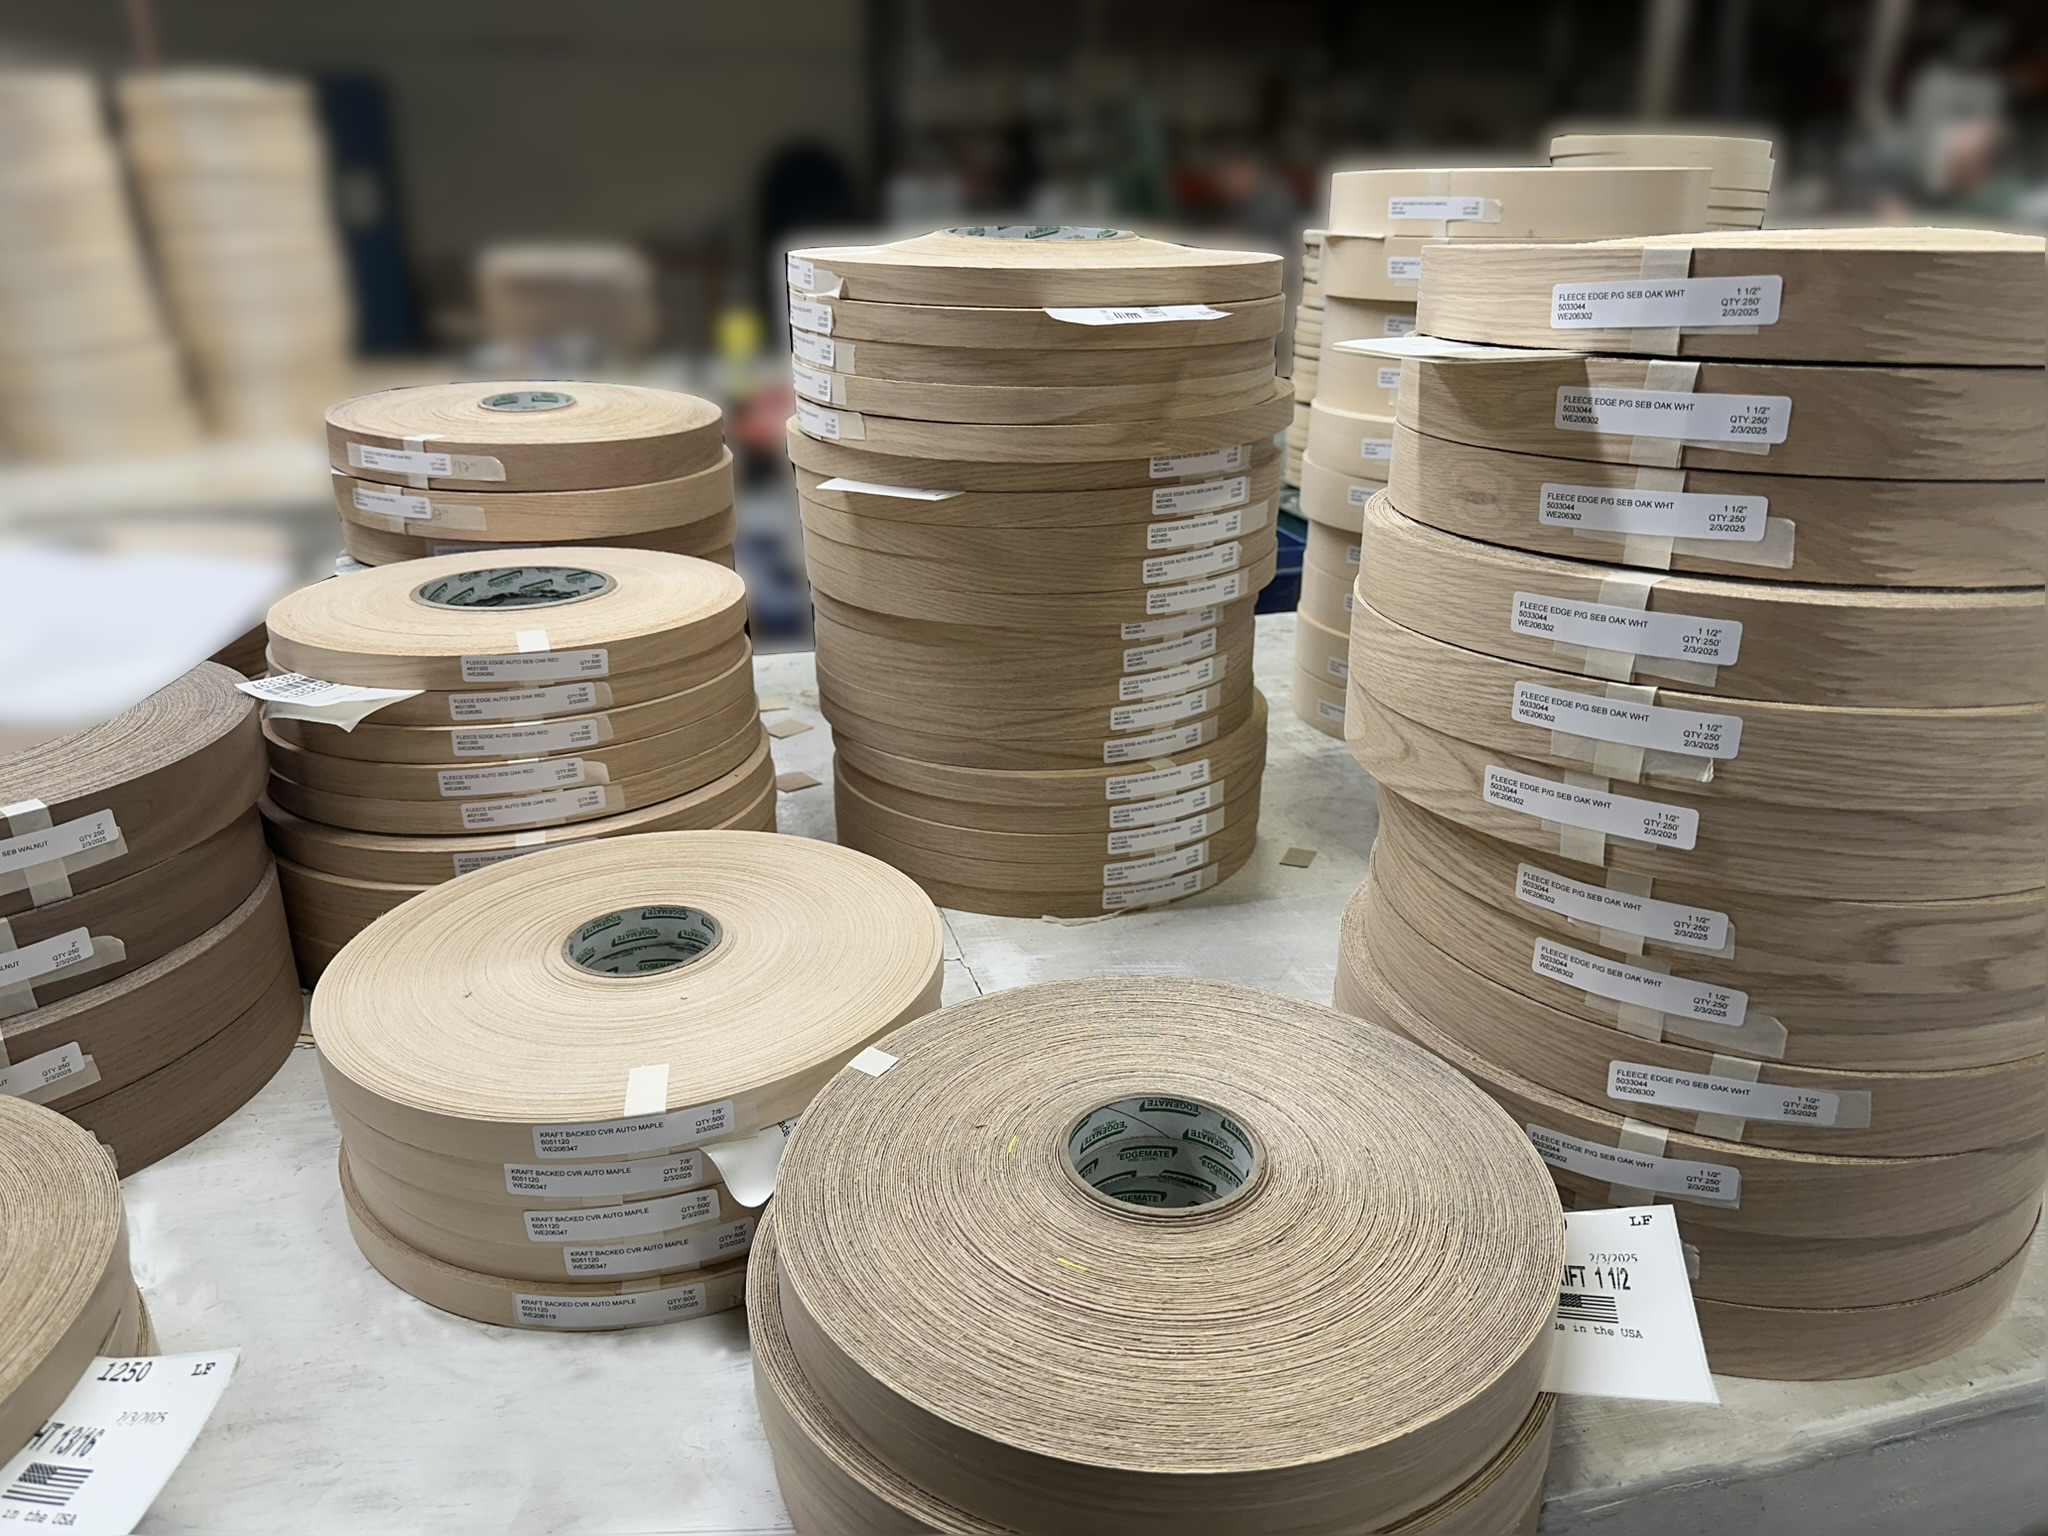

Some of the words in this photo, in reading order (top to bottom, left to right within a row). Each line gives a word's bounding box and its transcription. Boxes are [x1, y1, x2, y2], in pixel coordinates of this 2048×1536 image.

[1559, 293, 1586, 301] FLEECE
[1588, 292, 1609, 300] EDGE
[1627, 291, 1642, 299] SEB
[1644, 290, 1662, 298] OAK
[1665, 289, 1685, 297] WHT
[1558, 312, 1593, 320] WE206302
[1722, 308, 1759, 317] 2/3/2025
[1519, 610, 1548, 621] 5033044
[1520, 601, 1548, 612] FLEECE
[1550, 606, 1572, 617] EDGE
[1574, 610, 1588, 619] P/G
[1590, 612, 1606, 622] SEB
[1608, 615, 1626, 625] OAK
[1627, 618, 1648, 628] WHT
[1518, 619, 1554, 632] WE206302
[1683, 645, 1718, 656] 2/3/2025
[1490, 782, 1517, 795] 5033044
[1491, 774, 1518, 788] FLEECE
[1520, 781, 1540, 793] EDGE
[1542, 787, 1555, 797] P/G
[1556, 791, 1572, 801] SEB
[1574, 795, 1591, 805] OAK
[1592, 799, 1612, 809] WHT
[1489, 790, 1524, 806] WE206302
[1644, 827, 1677, 840] 2/3/2025
[81, 836, 107, 848] 2/3/2025
[2, 848, 17, 857] SEB
[18, 841, 48, 853] WALNUT
[617, 928, 658, 942] EDGEMATE
[0, 961, 19, 971] LNUT
[55, 954, 82, 967] 2/3/2025
[44, 1068, 72, 1083] 2/3/2025
[1616, 1077, 1648, 1087] 5033044
[1616, 1069, 1648, 1080] FLEECE
[1650, 1074, 1673, 1084] EDGE
[1675, 1078, 1690, 1087] P/G
[1692, 1081, 1709, 1089] SEB
[1711, 1083, 1728, 1093] OAK
[1731, 1087, 1750, 1096] WHT
[1615, 1085, 1655, 1096] WE206302
[1147, 1099, 1199, 1113] EDGEMATE
[1783, 1108, 1817, 1117] 2/3/2025
[598, 1128, 614, 1136] CVR
[616, 1126, 637, 1134] AUTO
[638, 1122, 664, 1131] MAPLE
[696, 1122, 724, 1134] 2/3/2025
[1084, 1121, 1125, 1145] EDGEMATE
[1191, 1129, 1234, 1156] EDGEMATE
[1532, 1139, 1560, 1153] 5033044
[1120, 1150, 1170, 1160] EDGEMATE
[1533, 1131, 1560, 1146] FLEECE
[1562, 1140, 1583, 1153] EDGE
[1585, 1148, 1598, 1158] P/G
[1600, 1152, 1615, 1161] SEB
[1617, 1156, 1634, 1166] OAK
[1636, 1160, 1654, 1169] WHT
[1536, 1148, 1567, 1163] E206302
[511, 1168, 534, 1176] KRAFT
[663, 1173, 692, 1182] 2/3/2025
[511, 1175, 539, 1183] 6051120
[1687, 1183, 1720, 1192] 2/3/2025
[1116, 1194, 1159, 1203] GEMATE
[1629, 1215, 1653, 1226] LF
[1589, 1253, 1638, 1264] 2/3/2025
[1562, 1265, 1586, 1287] IFT
[1595, 1267, 1603, 1289] 1
[1608, 1267, 1630, 1290] 1/2
[612, 1298, 636, 1306] MAPLE
[1573, 1324, 1587, 1333] in
[1594, 1326, 1614, 1336] the
[1620, 1328, 1643, 1339] USA
[97, 1361, 153, 1382] 1250
[191, 1362, 216, 1376] LF
[49, 1425, 105, 1458] 13/16
